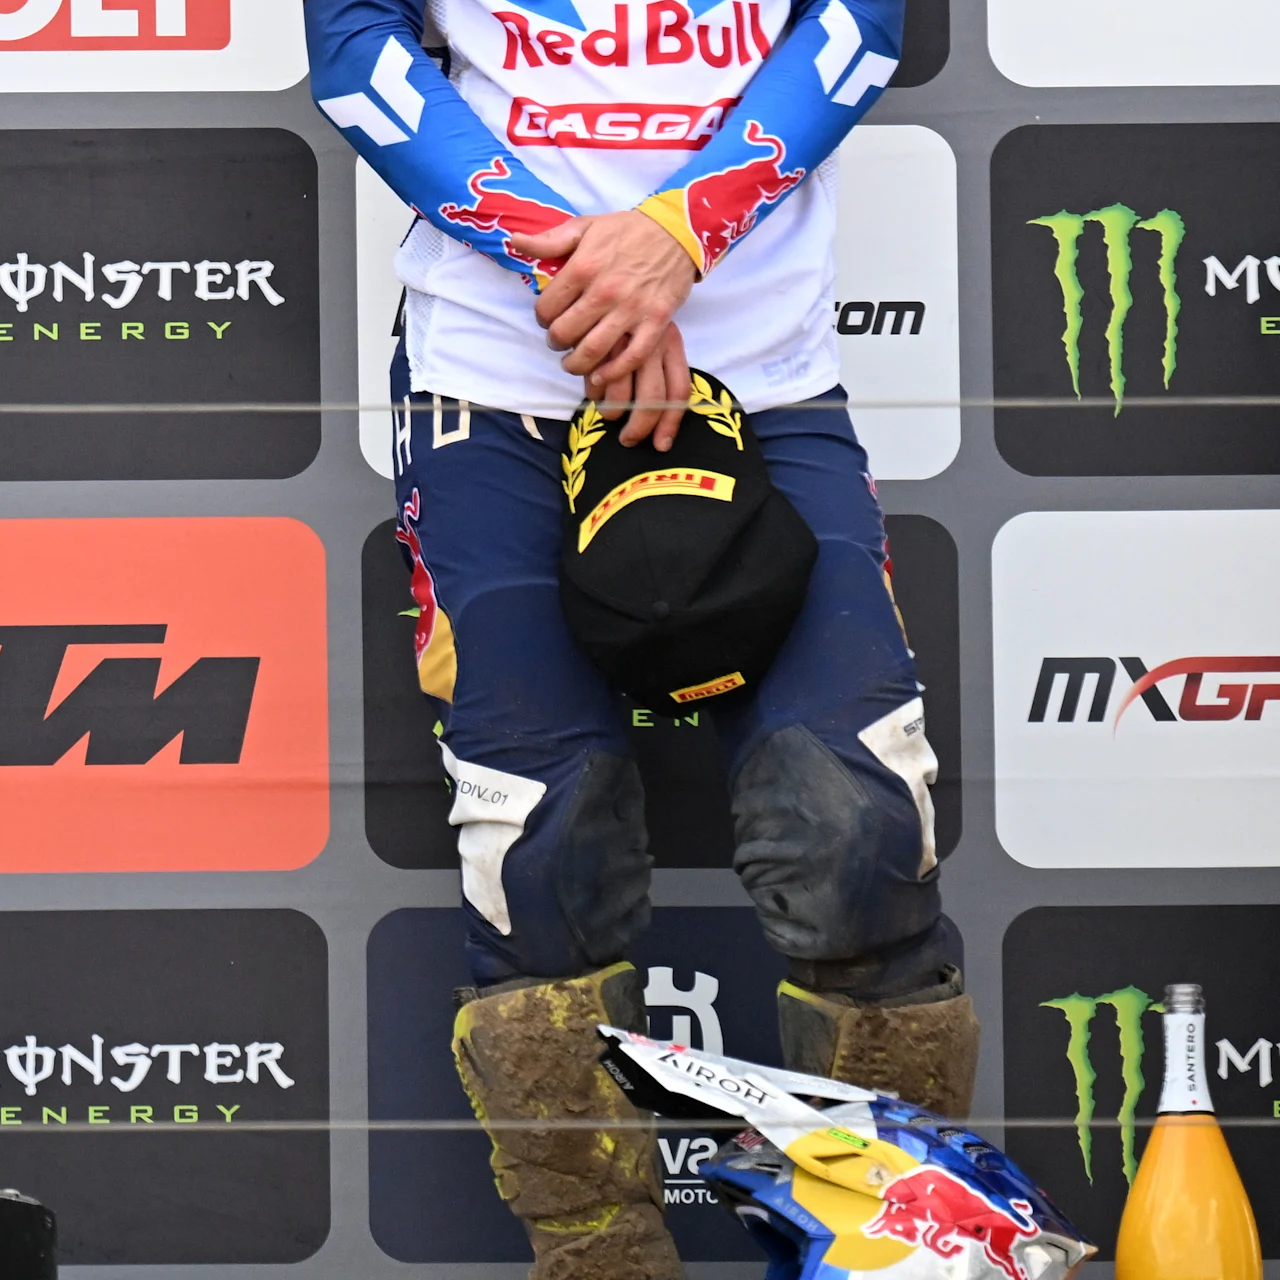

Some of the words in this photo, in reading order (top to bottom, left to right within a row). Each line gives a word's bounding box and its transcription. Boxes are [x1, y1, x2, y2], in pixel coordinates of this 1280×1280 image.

[490, 3, 632, 71] Red
[524, 106, 725, 143] GASGA
[659, 1052, 768, 1105] AIROH
[1187, 1022, 1196, 1092] SANTERO
[0, 1104, 242, 1125] ENERGY
